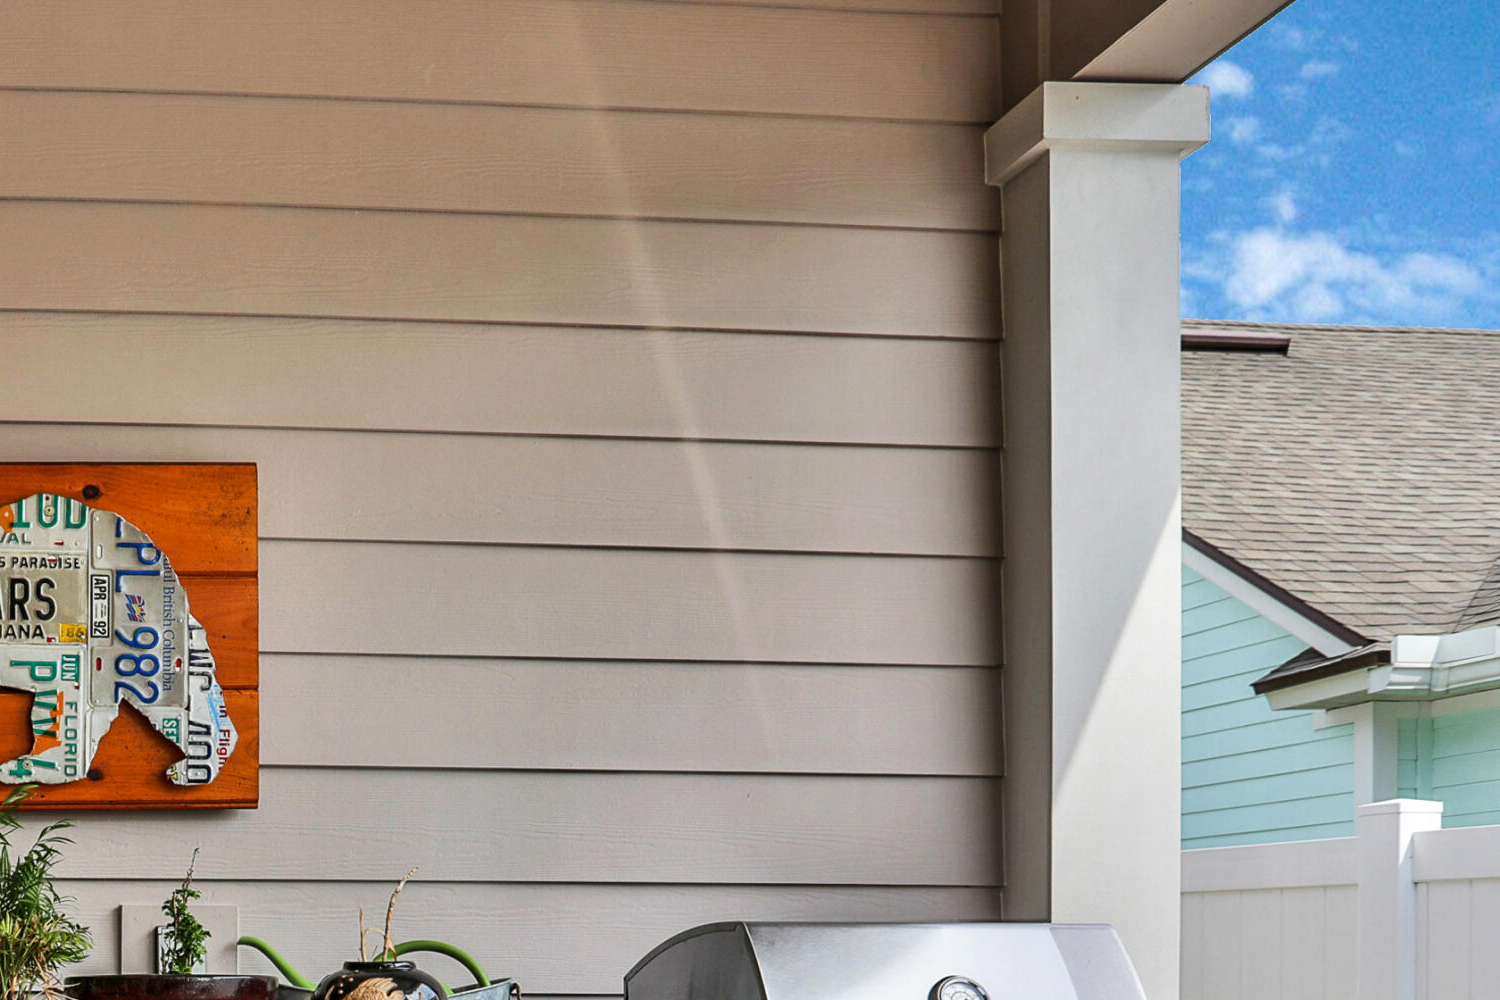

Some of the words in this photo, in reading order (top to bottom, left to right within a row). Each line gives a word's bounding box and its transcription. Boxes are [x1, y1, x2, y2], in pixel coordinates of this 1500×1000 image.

[94, 578, 107, 600] APR
[163, 586, 176, 629] British
[94, 621, 107, 635] 92
[62, 655, 77, 680] JUN
[115, 626, 160, 704] 982
[163, 631, 176, 692] Columbia
[65, 701, 78, 780] FLORID
[217, 729, 231, 771] Fligh
